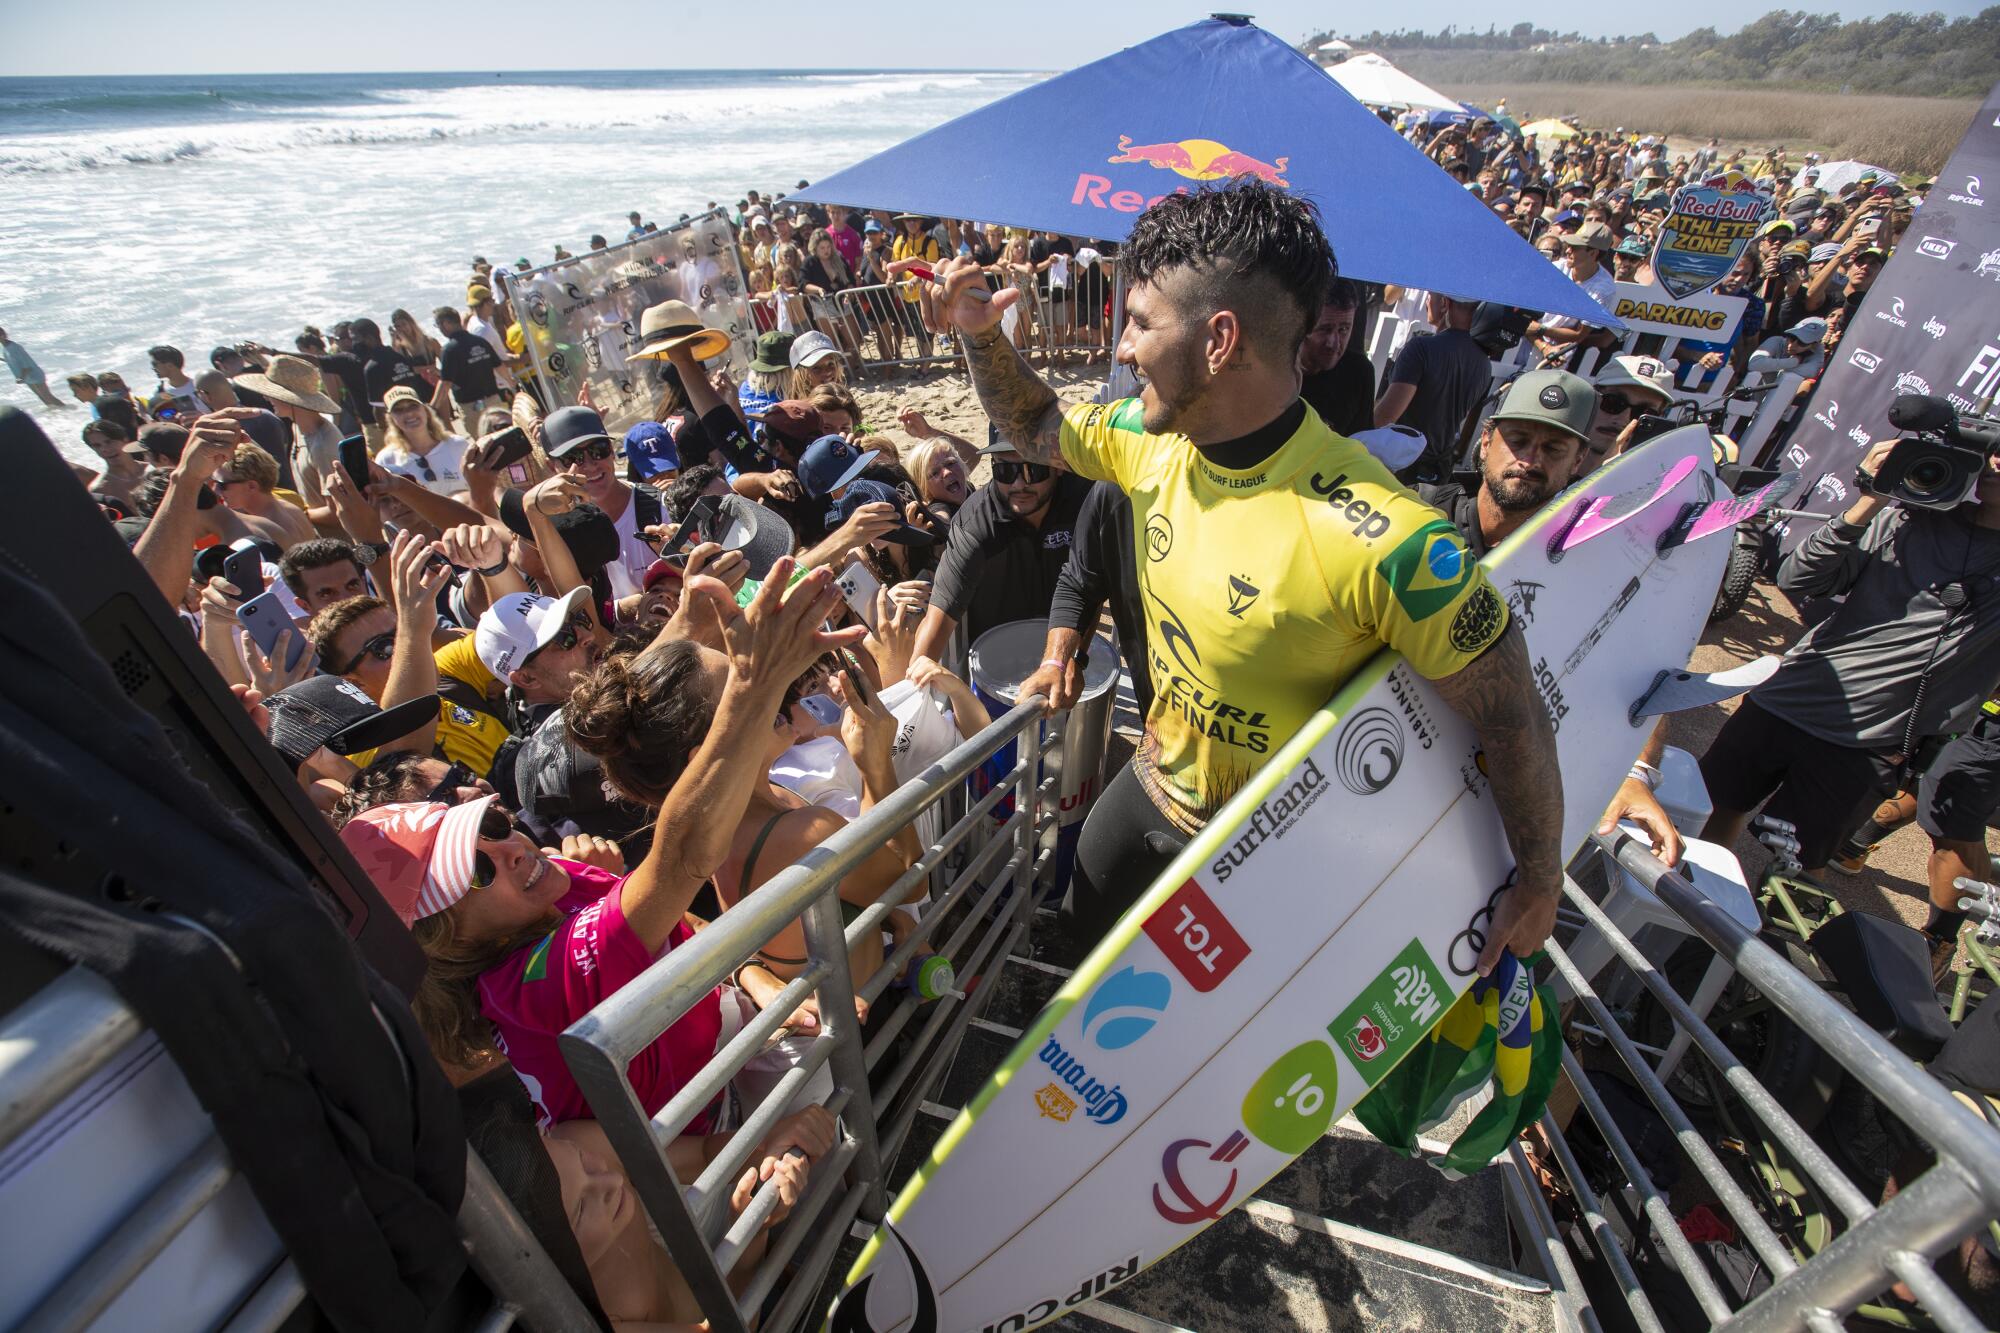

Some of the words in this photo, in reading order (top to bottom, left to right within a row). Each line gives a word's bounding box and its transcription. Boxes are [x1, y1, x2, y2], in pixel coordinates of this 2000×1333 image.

[1664, 213, 1759, 239] ATHLETE
[1680, 195, 1720, 217] Red
[1719, 200, 1760, 222] Bull
[1672, 232, 1732, 255] ZONE
[1922, 241, 1948, 254] IKEA
[1615, 299, 1727, 330] PARKING
[1923, 315, 1947, 339] Jeep
[1855, 353, 1877, 369] IKEA
[643, 437, 659, 454] T
[1848, 424, 1871, 447] Jeep
[1208, 470, 1229, 487] SURF
[1229, 472, 1268, 488] LEAGUE
[1310, 471, 1391, 539] Jeep
[1170, 675, 1271, 729] CURL
[1397, 662, 1440, 739] SURFBOARDS
[1533, 656, 1570, 722] PRIDE
[1171, 690, 1270, 754] FINALS
[1387, 670, 1433, 750] CABIANCA
[1212, 756, 1326, 883] surfland
[1297, 781, 1331, 817] GAROPABA
[1173, 904, 1223, 974] TCL
[1390, 964, 1441, 1027] Natu
[1372, 1001, 1404, 1042] Guaraná
[1039, 1039, 1128, 1125] Corona
[1065, 1255, 1139, 1306] RIP
